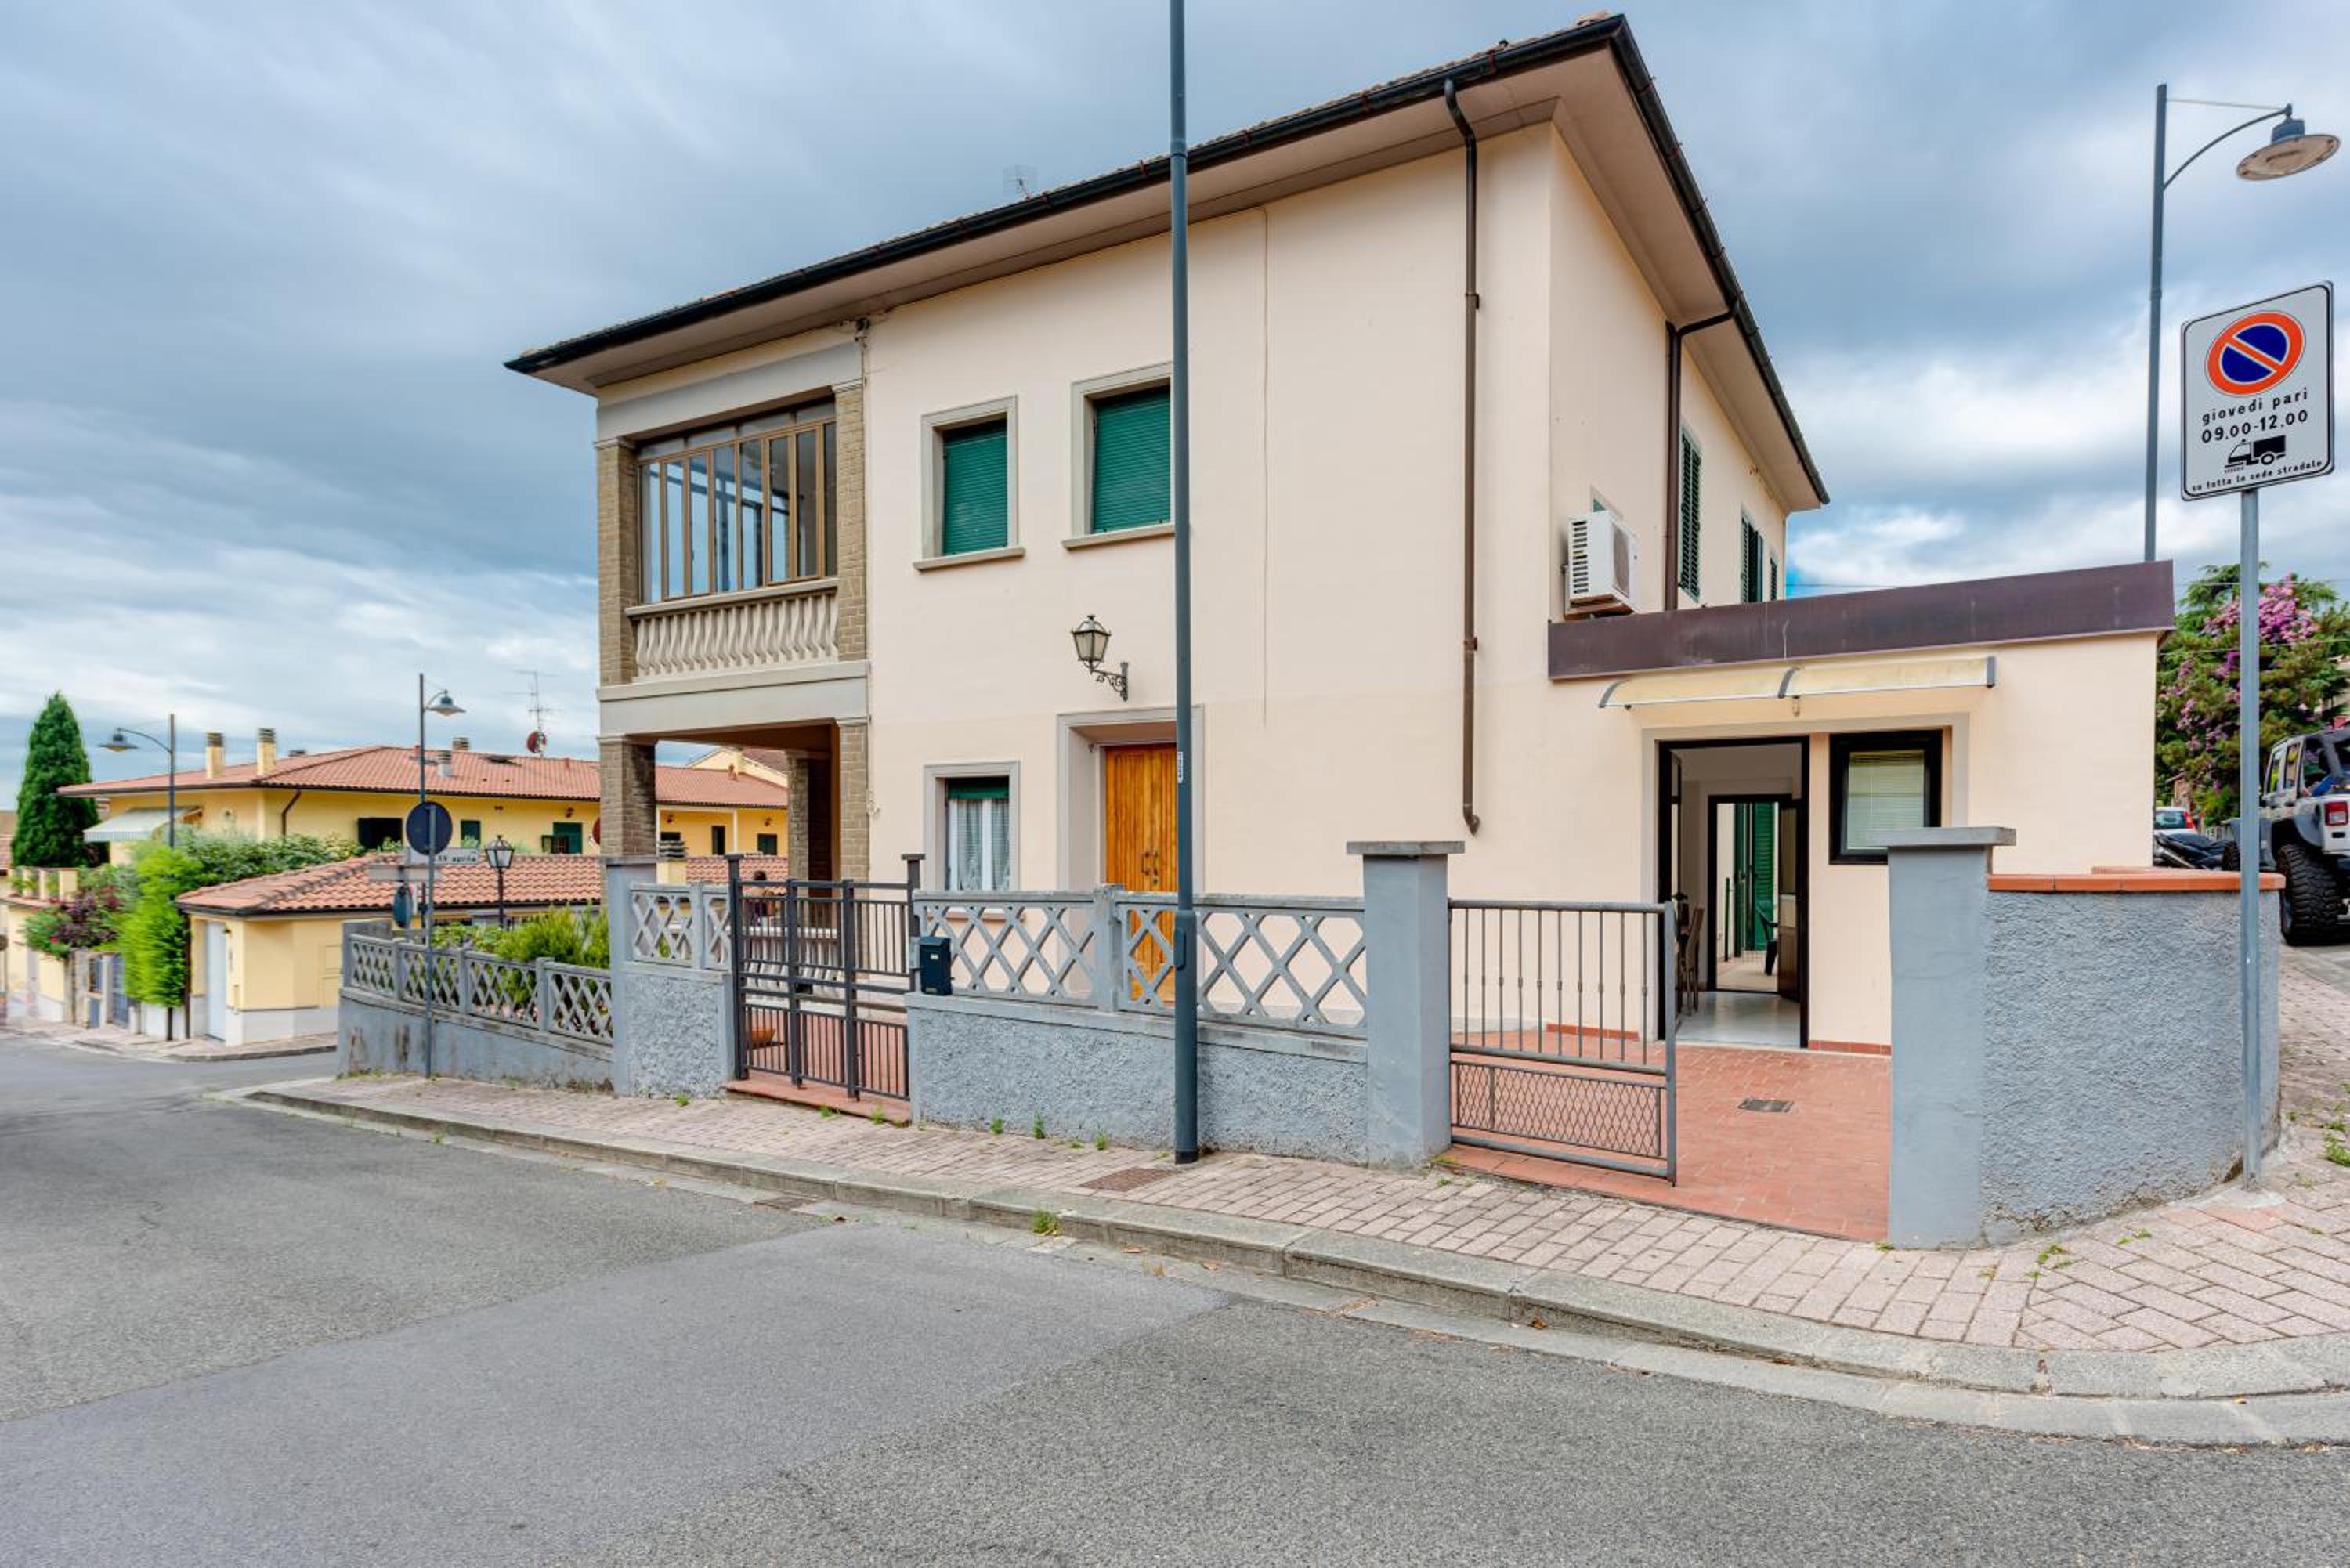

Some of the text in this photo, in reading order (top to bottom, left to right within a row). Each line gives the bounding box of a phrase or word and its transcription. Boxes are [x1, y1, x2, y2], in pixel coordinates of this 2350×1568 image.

[2202, 387, 2307, 426] giovedi pari
[2202, 410, 2308, 443] 09.00-12.00
[2277, 460, 2323, 475] stradale
